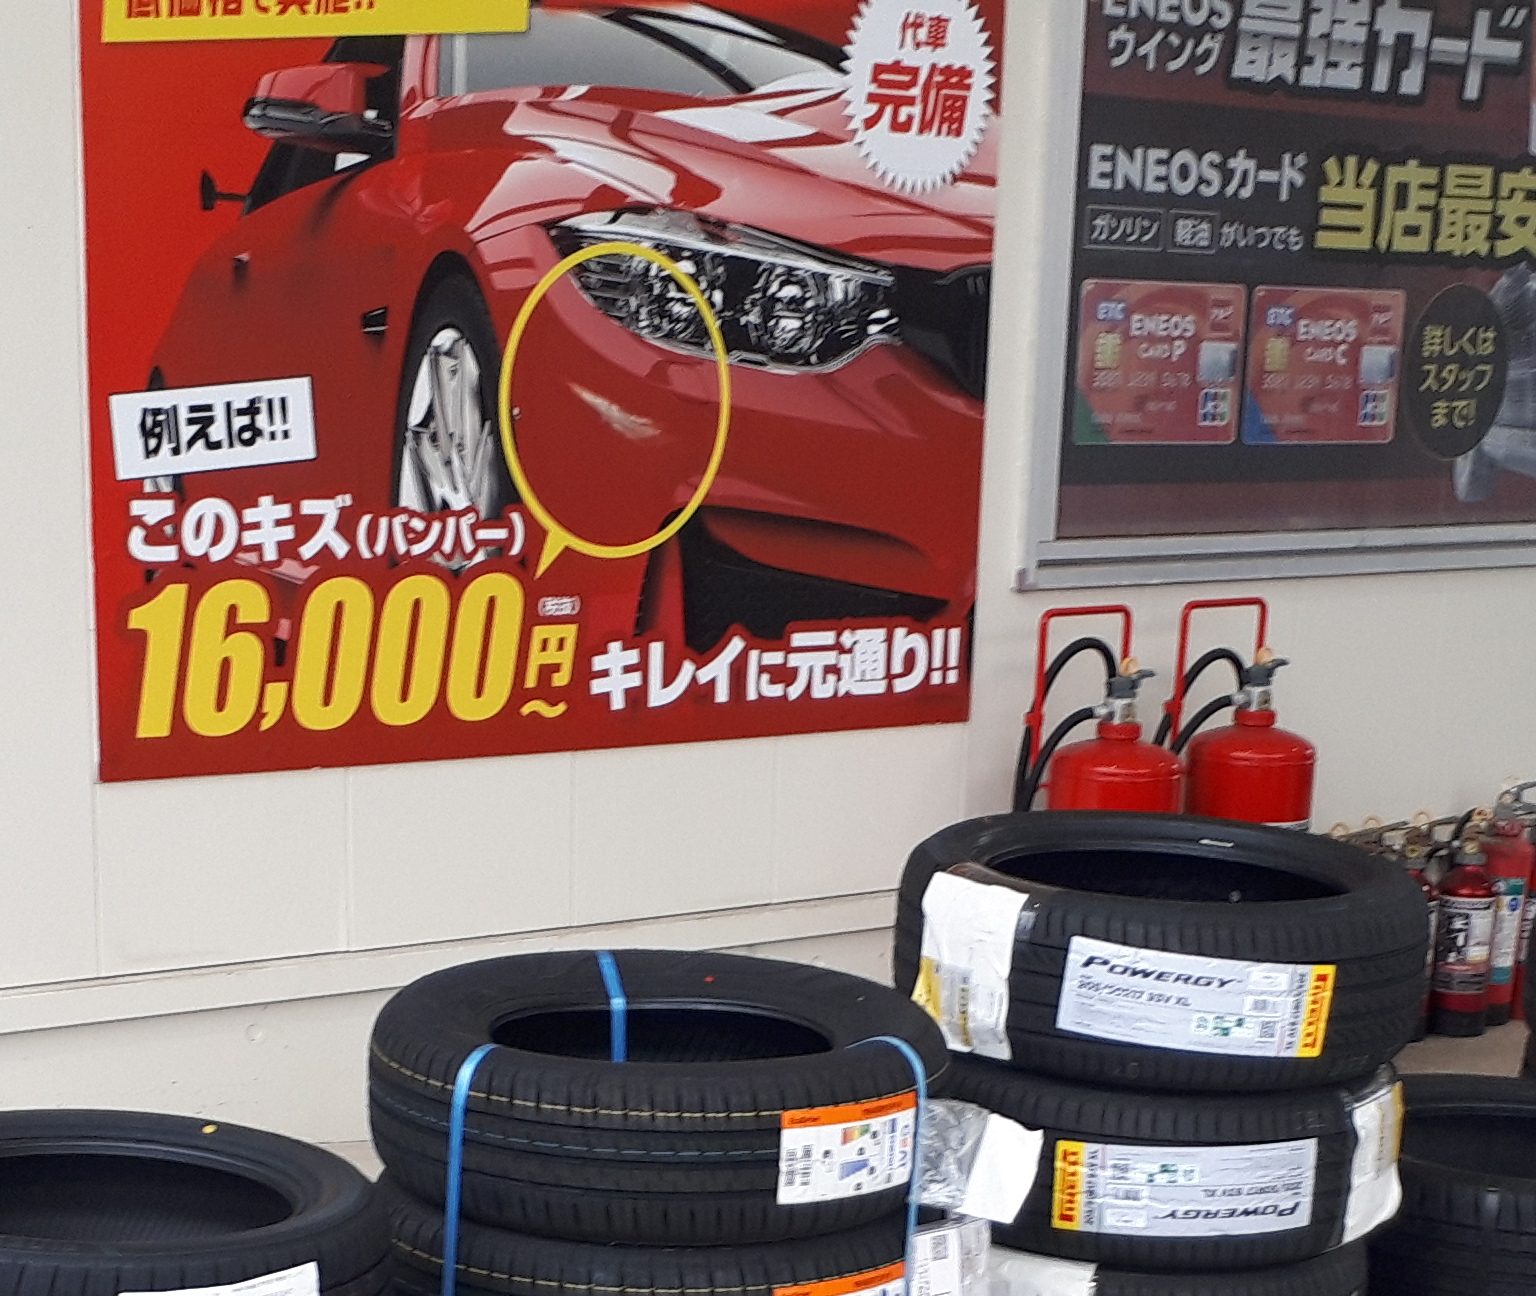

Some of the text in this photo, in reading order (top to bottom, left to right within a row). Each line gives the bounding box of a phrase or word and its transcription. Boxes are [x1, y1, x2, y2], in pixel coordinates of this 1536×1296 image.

[898, 10, 952, 52] 代車
[1105, 24, 1225, 76] ウイング
[863, 60, 975, 138] 完備
[1087, 142, 1310, 203] ENEOSカード
[1419, 323, 1497, 358] 詳しくは
[1418, 364, 1494, 393] スタッフ
[138, 396, 291, 460] 例えば!!
[588, 626, 962, 711] キレイに元通り!!
